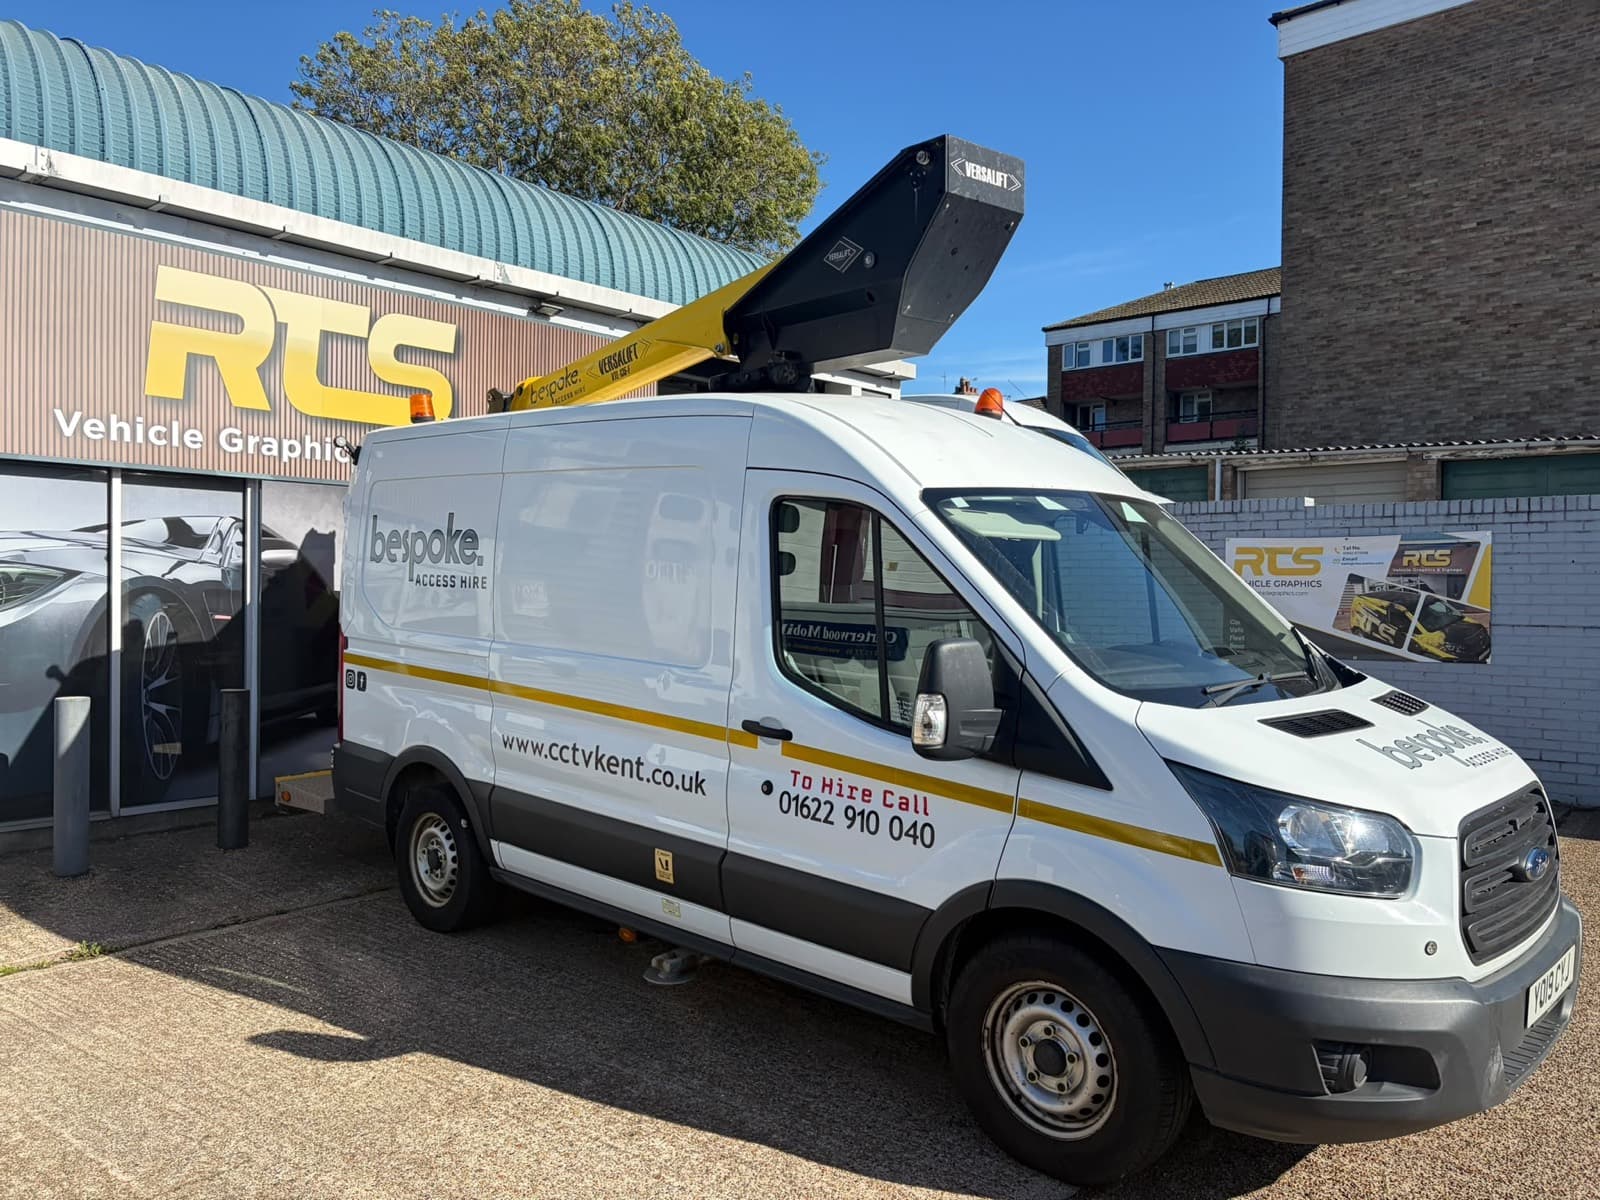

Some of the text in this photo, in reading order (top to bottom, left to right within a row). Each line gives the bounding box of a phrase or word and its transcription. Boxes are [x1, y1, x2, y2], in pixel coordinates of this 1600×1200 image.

[965, 160, 1008, 189] VERSALIFT
[145, 265, 457, 426] RTS
[598, 342, 638, 375] VERSALIFT
[53, 408, 204, 449] Vehicle
[370, 512, 484, 582] bespoke.
[1233, 547, 1324, 576] RTS
[415, 573, 487, 589] ACCESS HIRE
[1246, 580, 1322, 588] HICLE GRAPHICS
[501, 734, 706, 796] www.cctvkent.co.uk
[790, 769, 929, 816] To Hire Call
[779, 791, 935, 849] 01622 910 040
[1555, 952, 1571, 992] CYJ
